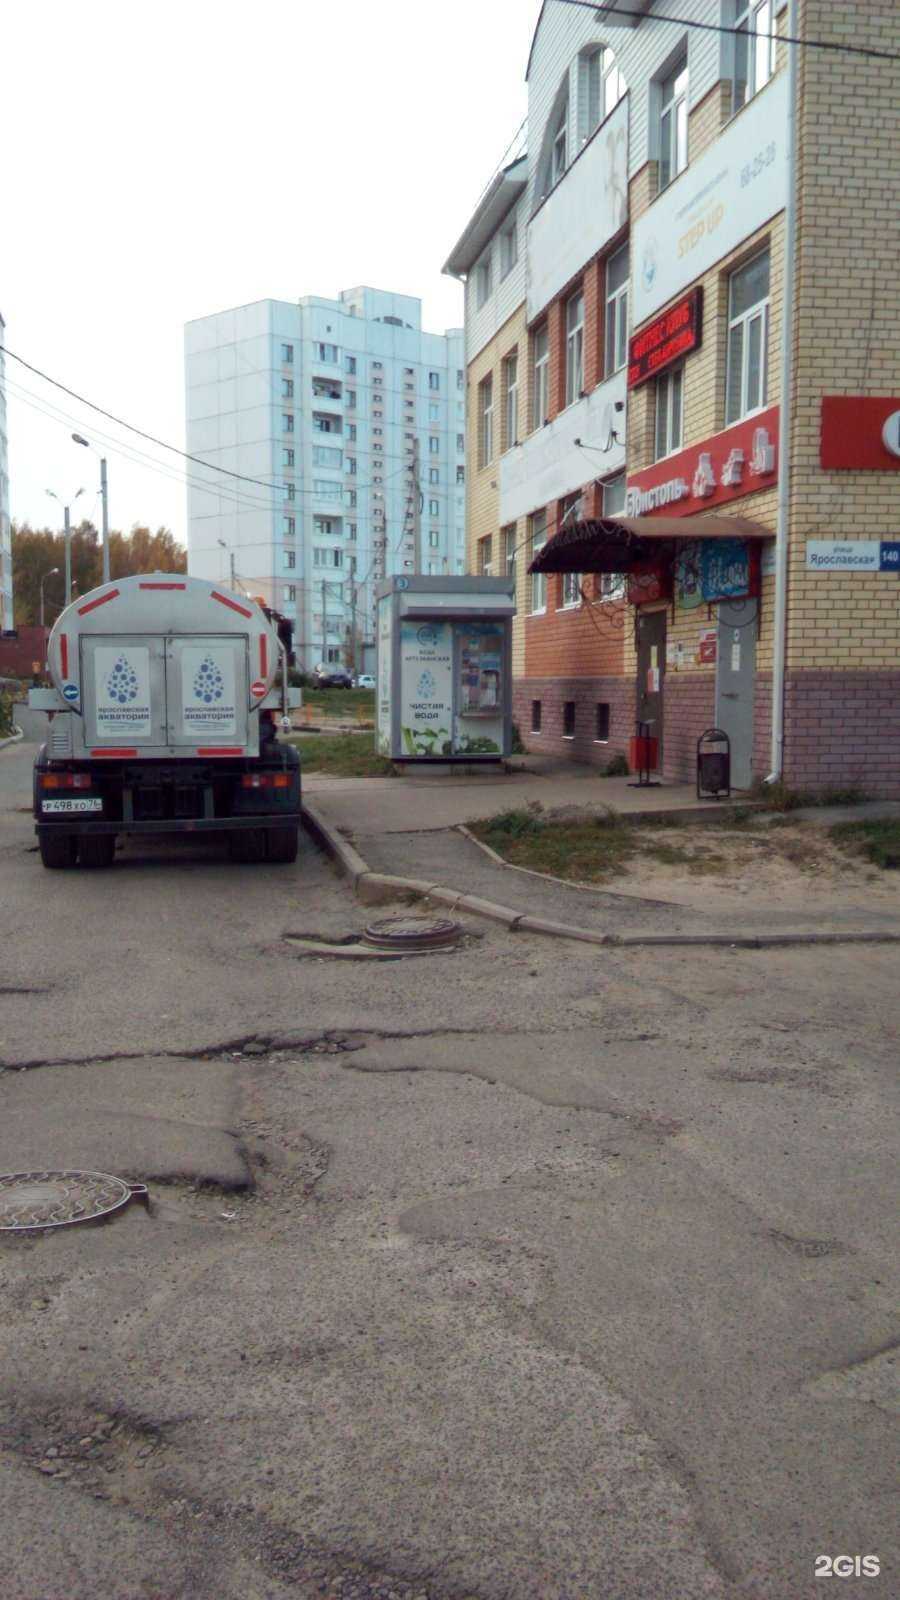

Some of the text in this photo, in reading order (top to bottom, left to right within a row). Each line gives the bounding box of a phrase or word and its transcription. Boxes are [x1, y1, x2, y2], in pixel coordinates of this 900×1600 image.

[677, 220, 706, 259] STEP
[707, 202, 725, 235] UP
[624, 477, 686, 519] Бристоль
[810, 550, 899, 567] Ярославская 140
[409, 703, 444, 711] ЧИСТАЯ
[97, 713, 150, 721] акватория
[184, 713, 235, 721] акватория
[414, 712, 439, 720] ВОДА
